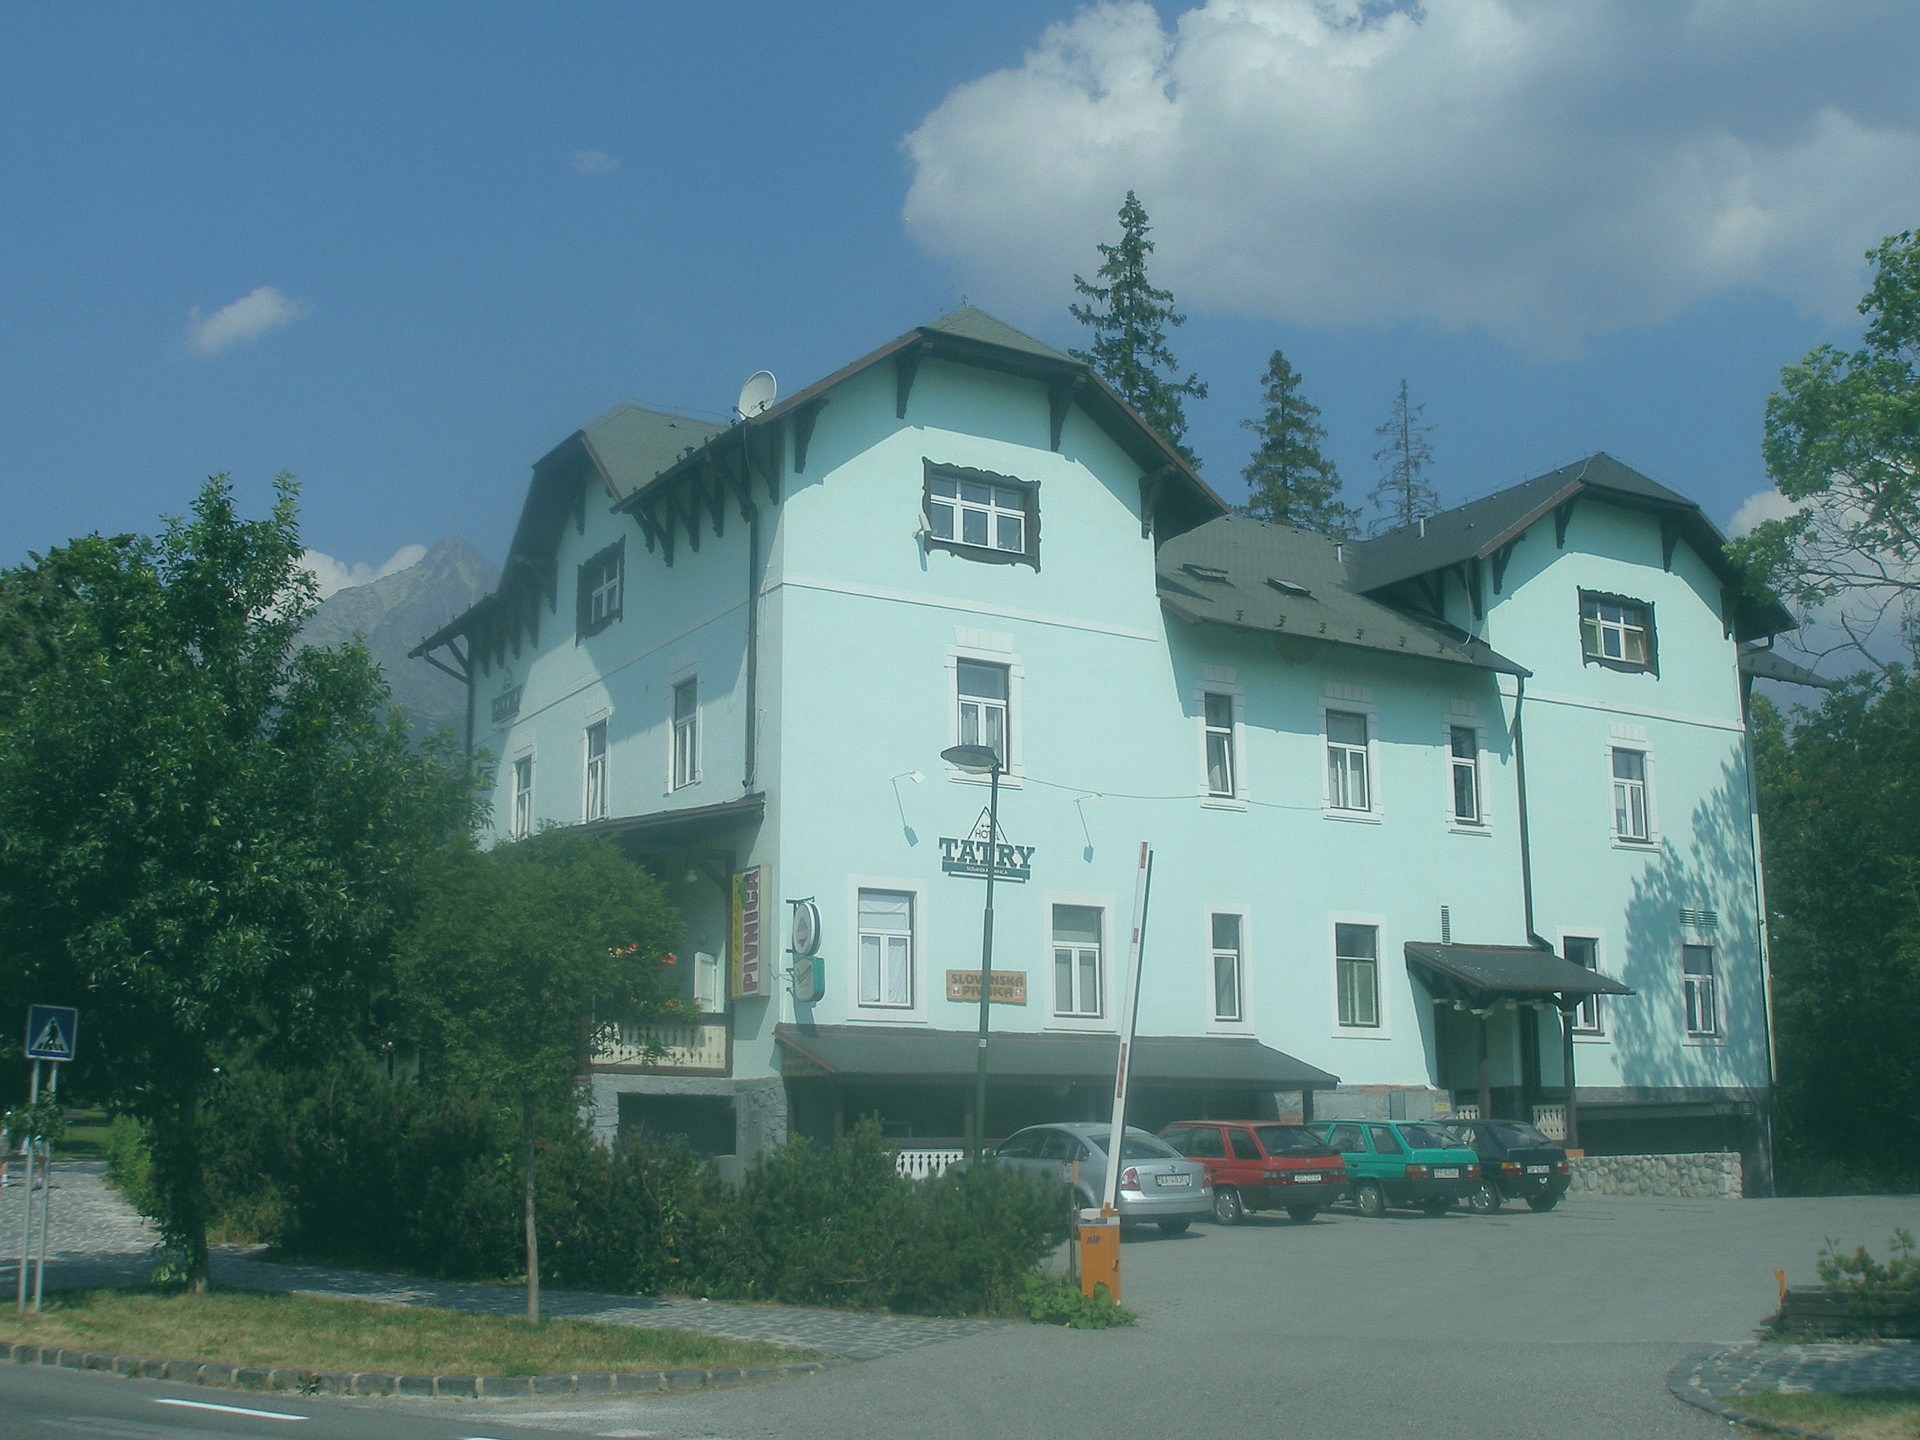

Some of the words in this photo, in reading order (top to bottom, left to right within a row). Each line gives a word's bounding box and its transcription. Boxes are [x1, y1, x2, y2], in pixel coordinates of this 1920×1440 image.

[939, 837, 1036, 870] TATRY
[743, 870, 759, 993] PIVNICA
[951, 974, 1024, 987] SLOVNSKÁ
[962, 985, 1013, 998] PIVICA
